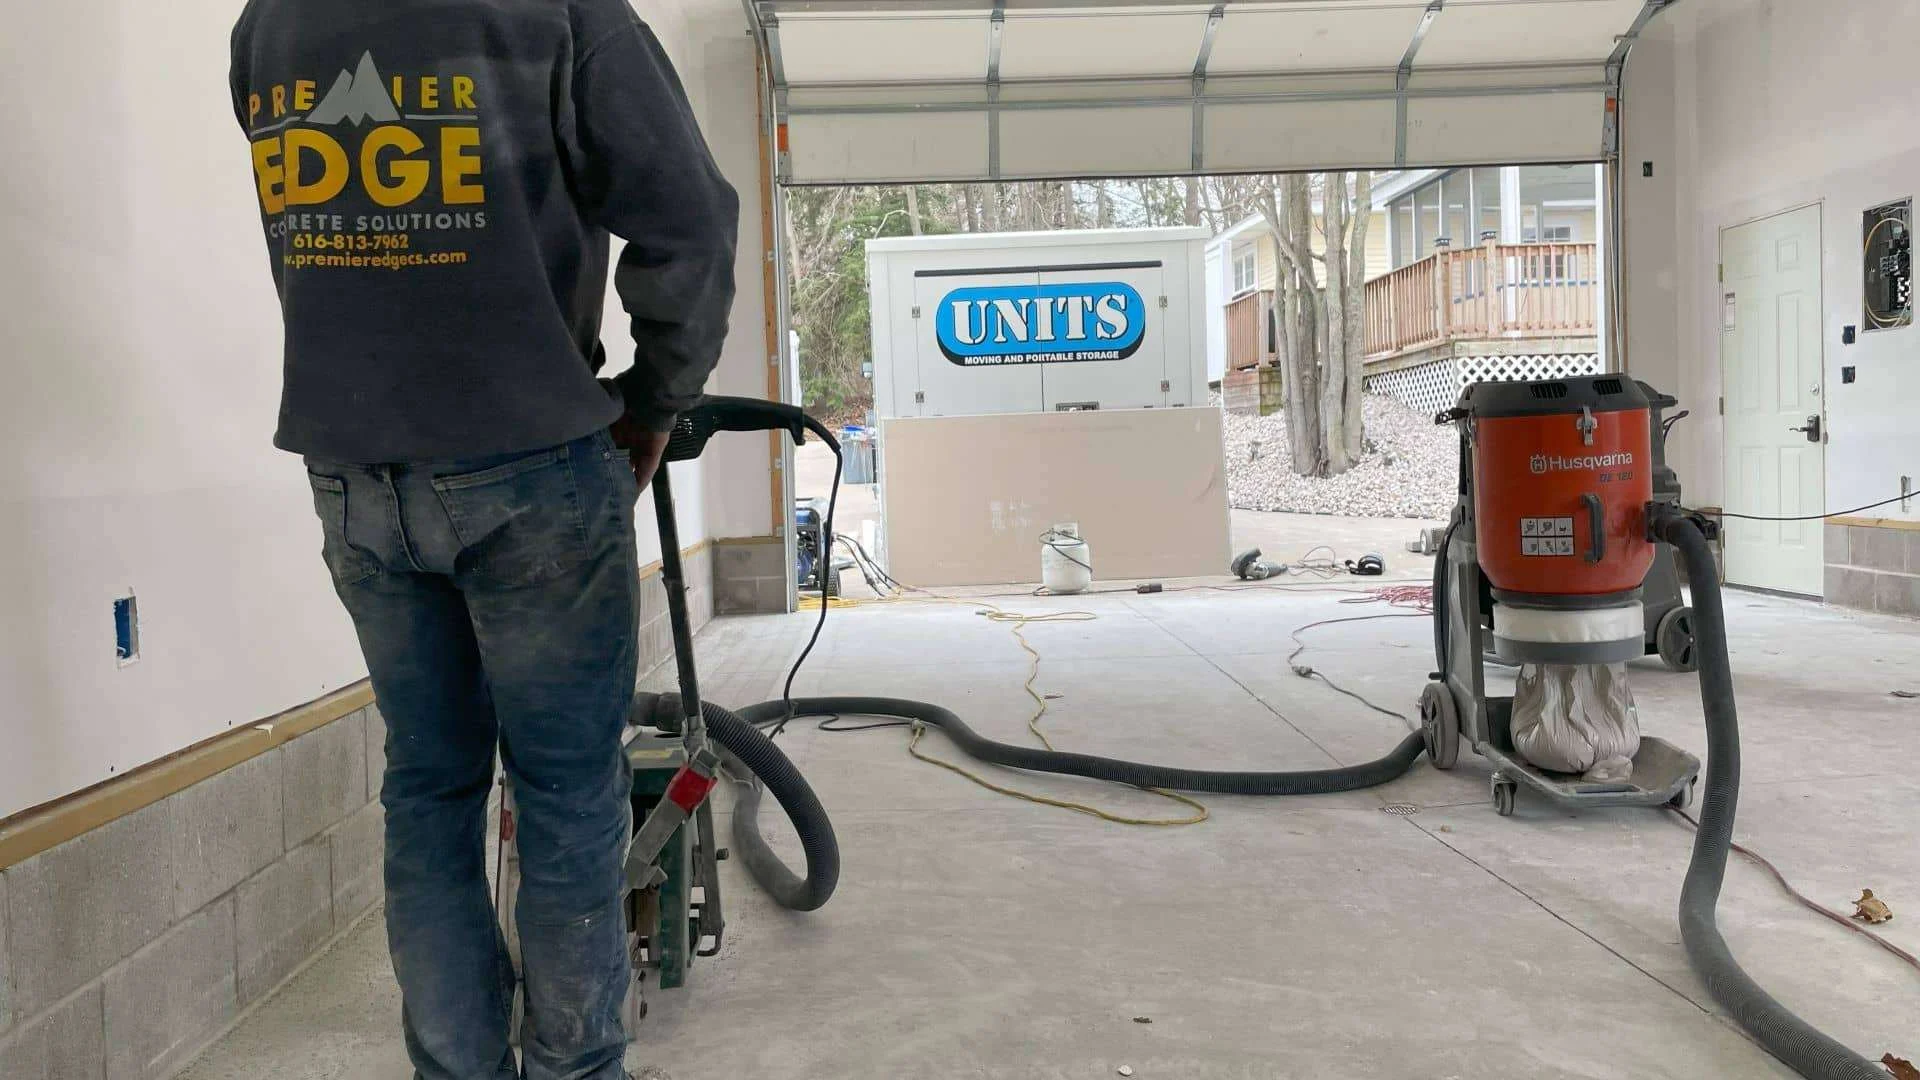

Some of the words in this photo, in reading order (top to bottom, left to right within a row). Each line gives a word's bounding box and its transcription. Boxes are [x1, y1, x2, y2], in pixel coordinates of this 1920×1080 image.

[251, 125, 485, 215] EDGE
[356, 211, 486, 231] SOLUTIONS
[294, 233, 409, 249] 616-813-7962
[951, 293, 1128, 345] UNITS
[964, 355, 1001, 365] MOVING
[1004, 355, 1024, 364] AND
[1026, 352, 1074, 362] PORTABLE
[1076, 351, 1119, 361] STORAGE
[1550, 452, 1633, 470] Husqvarna
